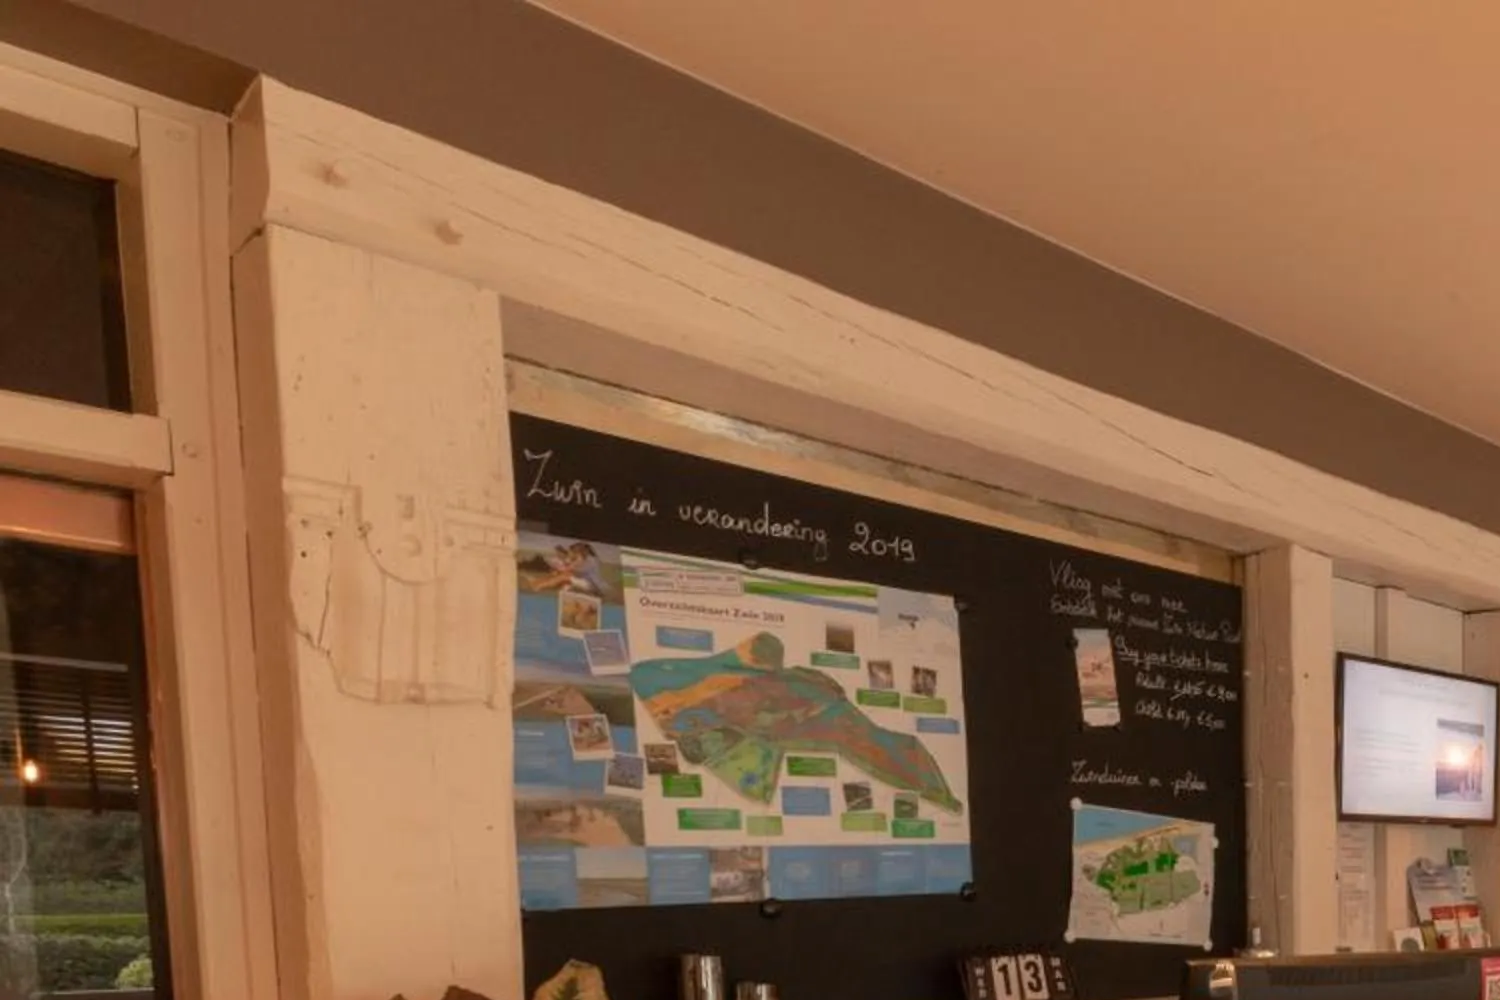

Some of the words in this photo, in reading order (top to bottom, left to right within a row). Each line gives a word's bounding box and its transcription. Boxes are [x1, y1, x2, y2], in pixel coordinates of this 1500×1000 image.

[523, 447, 601, 508] Zwin
[627, 487, 656, 517] in
[679, 501, 828, 561] verandering
[848, 521, 916, 562] 2019
[996, 960, 1044, 997] 13
